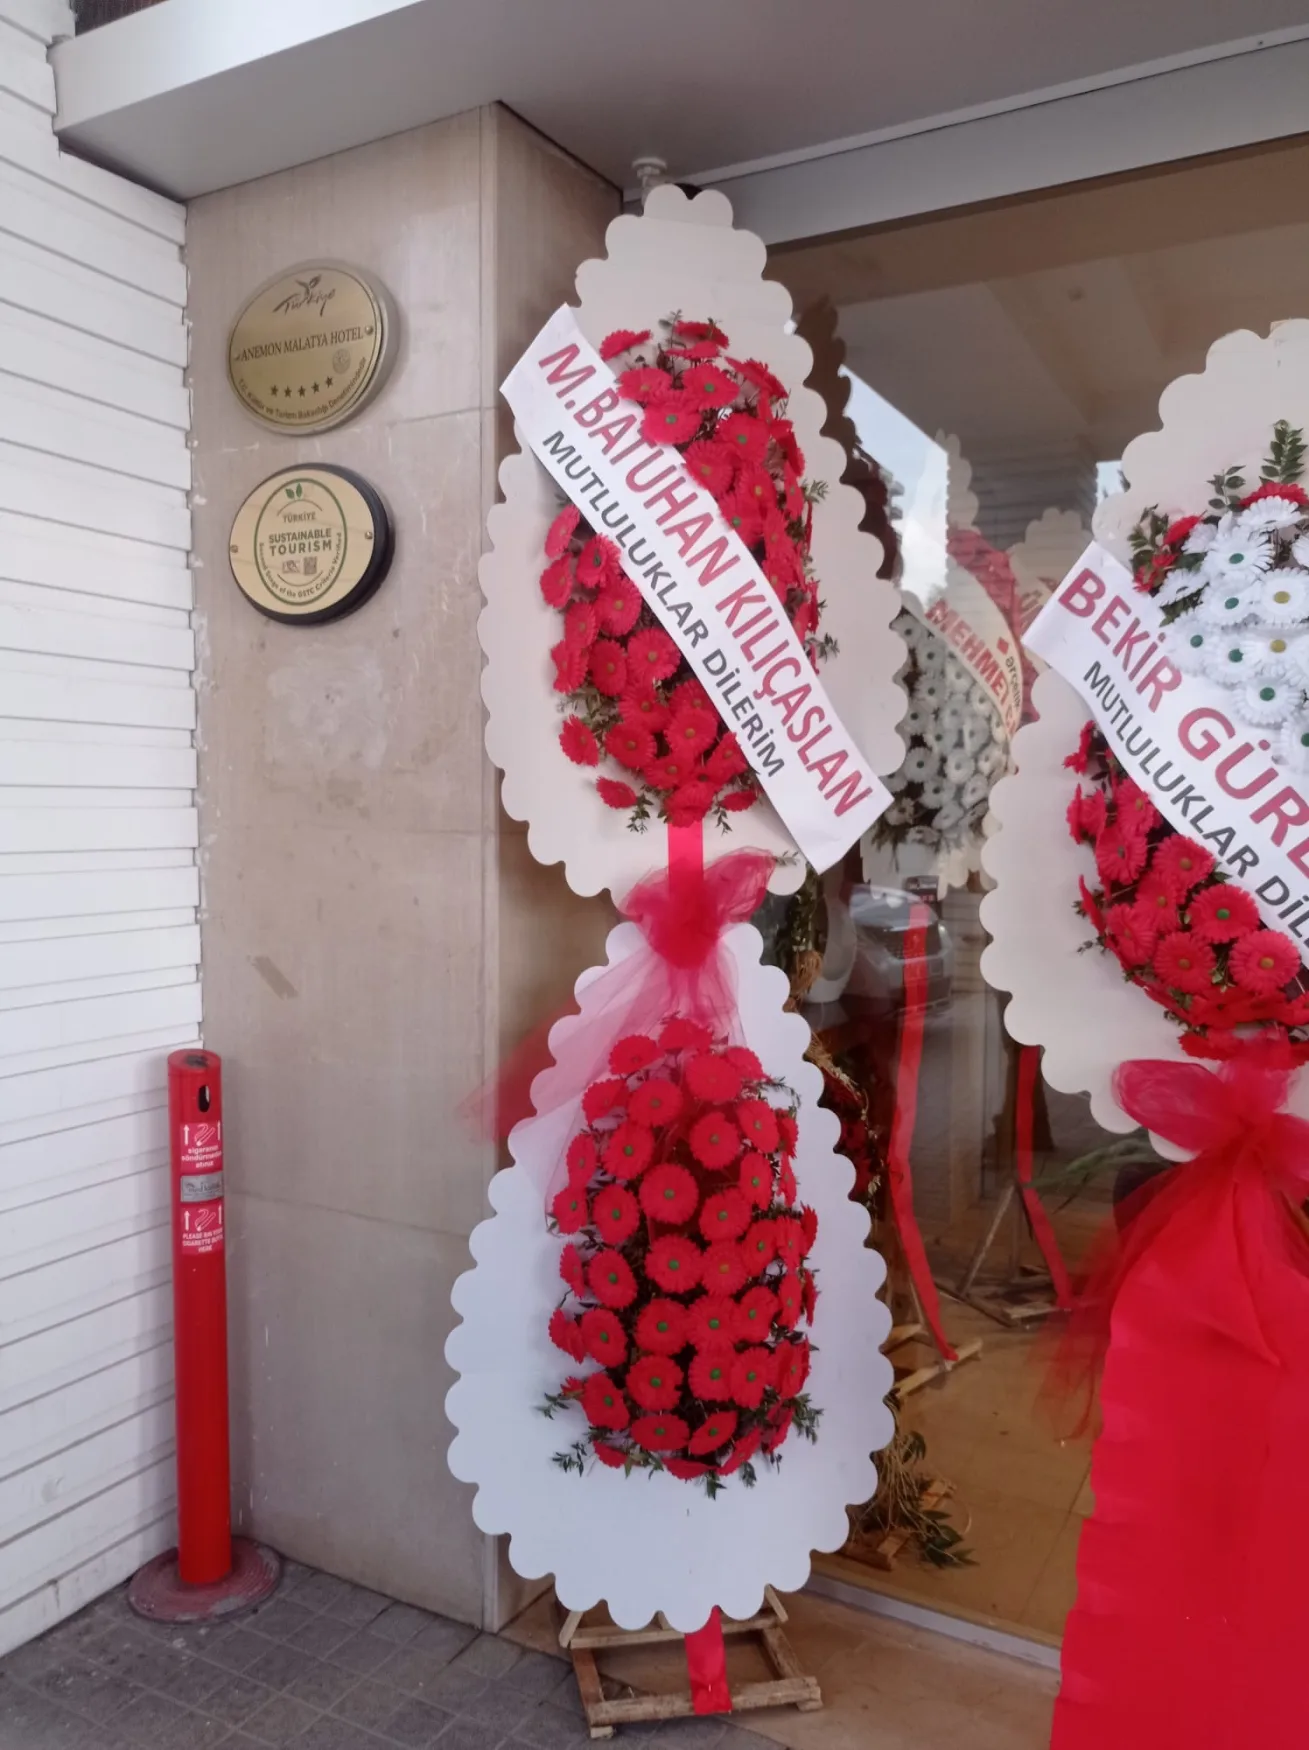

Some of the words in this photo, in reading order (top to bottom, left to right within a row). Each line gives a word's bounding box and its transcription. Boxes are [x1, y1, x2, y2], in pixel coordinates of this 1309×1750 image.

[241, 342, 282, 361] ANEMON
[284, 334, 328, 354] MALATYA
[330, 326, 364, 345] HOTEL
[283, 511, 316, 524] TÜRKİYE
[268, 528, 332, 544] SUSTAINABLE
[269, 539, 332, 557] TOURISM
[286, 590, 296, 599] the
[539, 343, 742, 588] M.BATUHAN
[715, 577, 873, 818] KILIÇASLAN
[542, 430, 709, 648] MUTLULUKLAR
[702, 649, 786, 778] DİLERİM
[1058, 567, 1182, 713] BEKİR
[1083, 660, 1260, 878] MUTLULUKLAR
[1255, 875, 1309, 951] DİL
